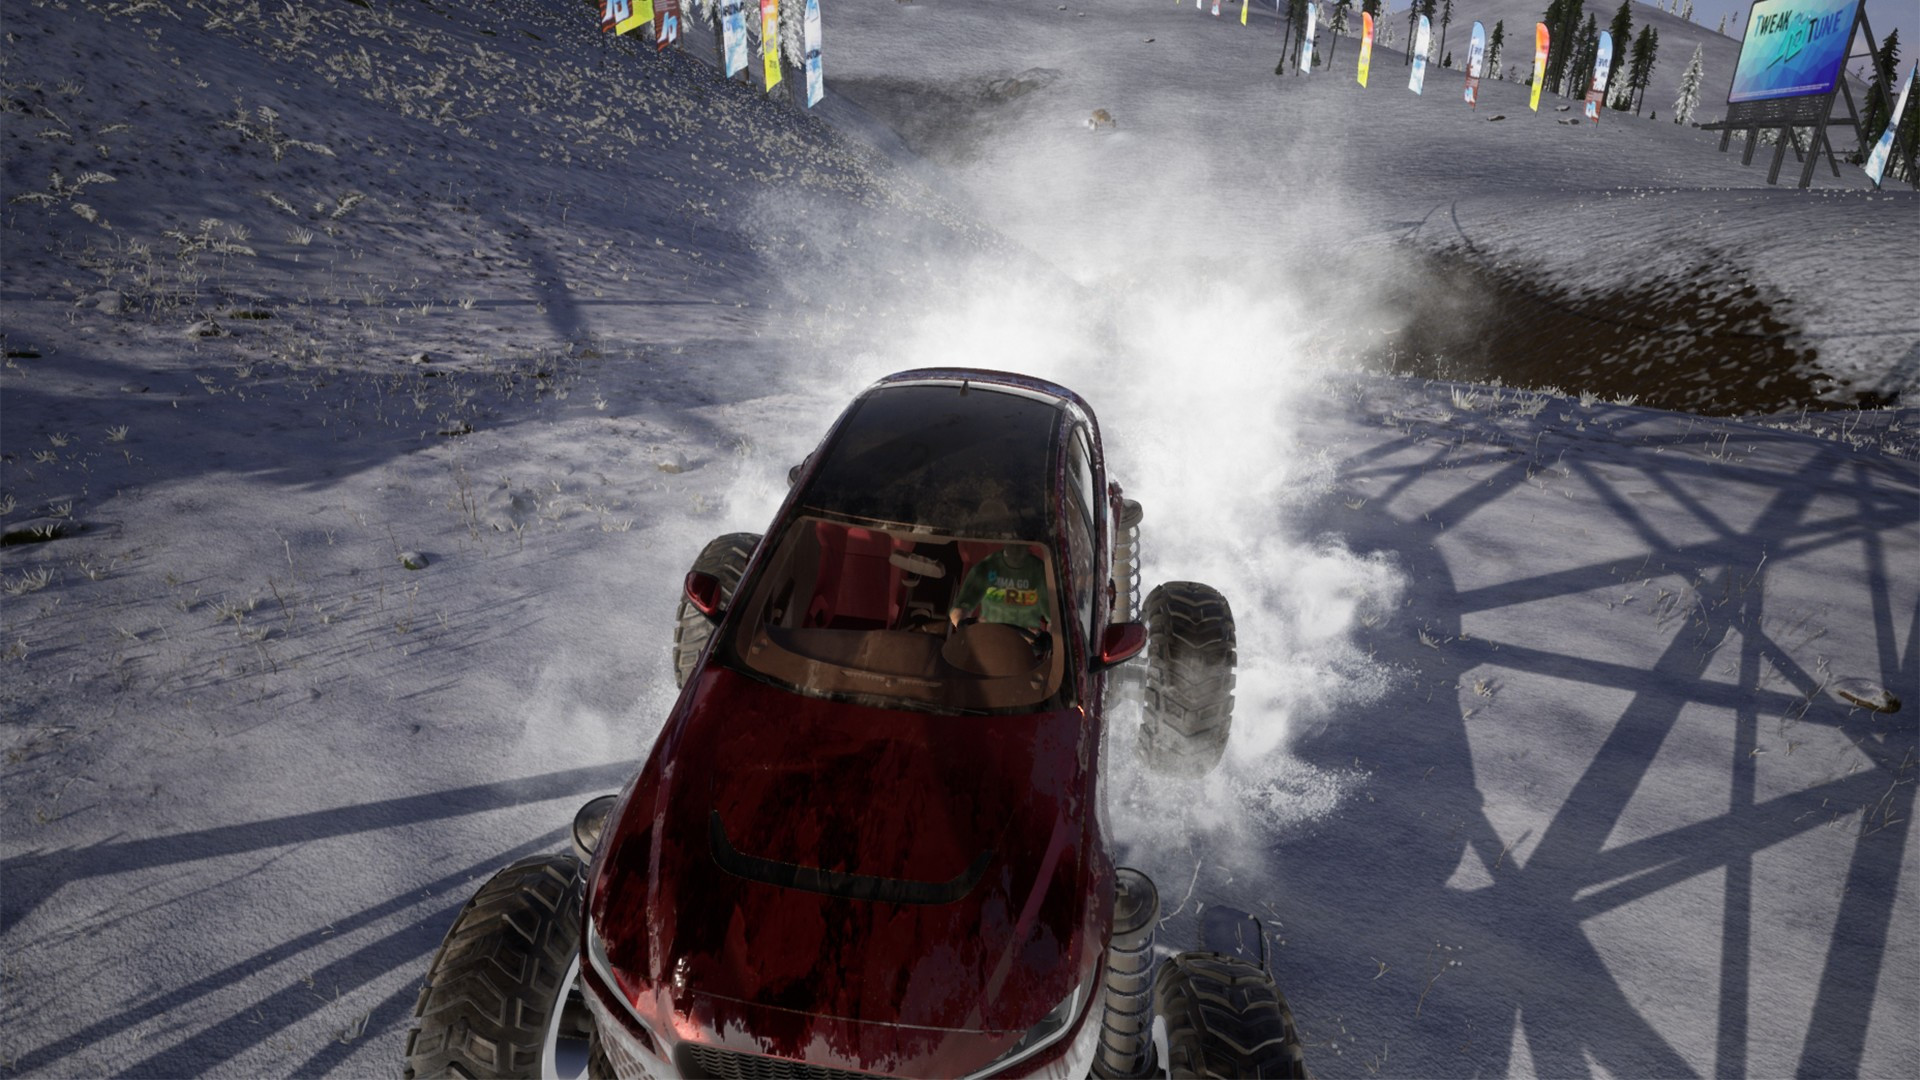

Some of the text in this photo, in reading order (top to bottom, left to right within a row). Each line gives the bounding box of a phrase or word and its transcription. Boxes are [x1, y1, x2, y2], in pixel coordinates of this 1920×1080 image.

[1755, 10, 1843, 43] TWEAK TUNE
[1017, 579, 1029, 589] GO
